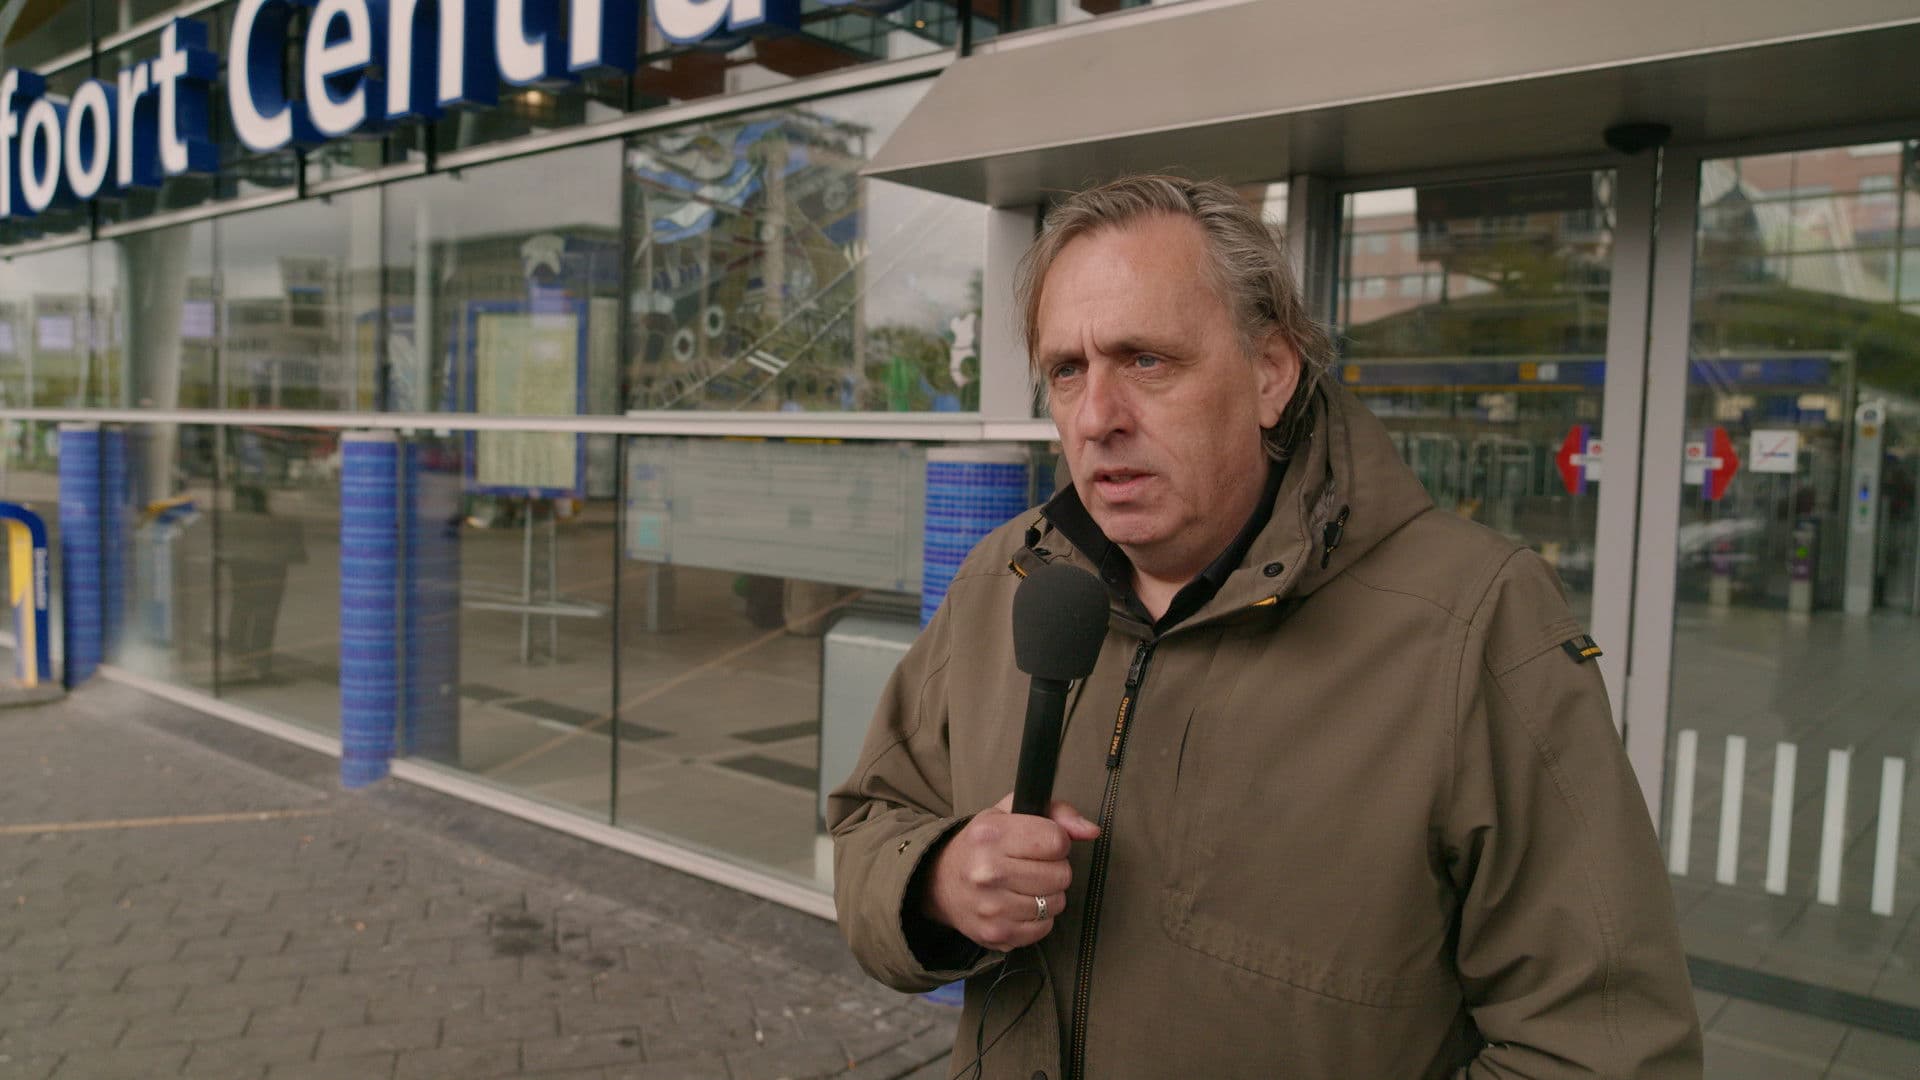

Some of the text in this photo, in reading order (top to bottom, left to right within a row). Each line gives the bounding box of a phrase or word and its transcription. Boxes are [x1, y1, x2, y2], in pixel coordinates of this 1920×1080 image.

[0, 0, 764, 217] foort Cen
[1110, 696, 1129, 756] PME LEGEND
